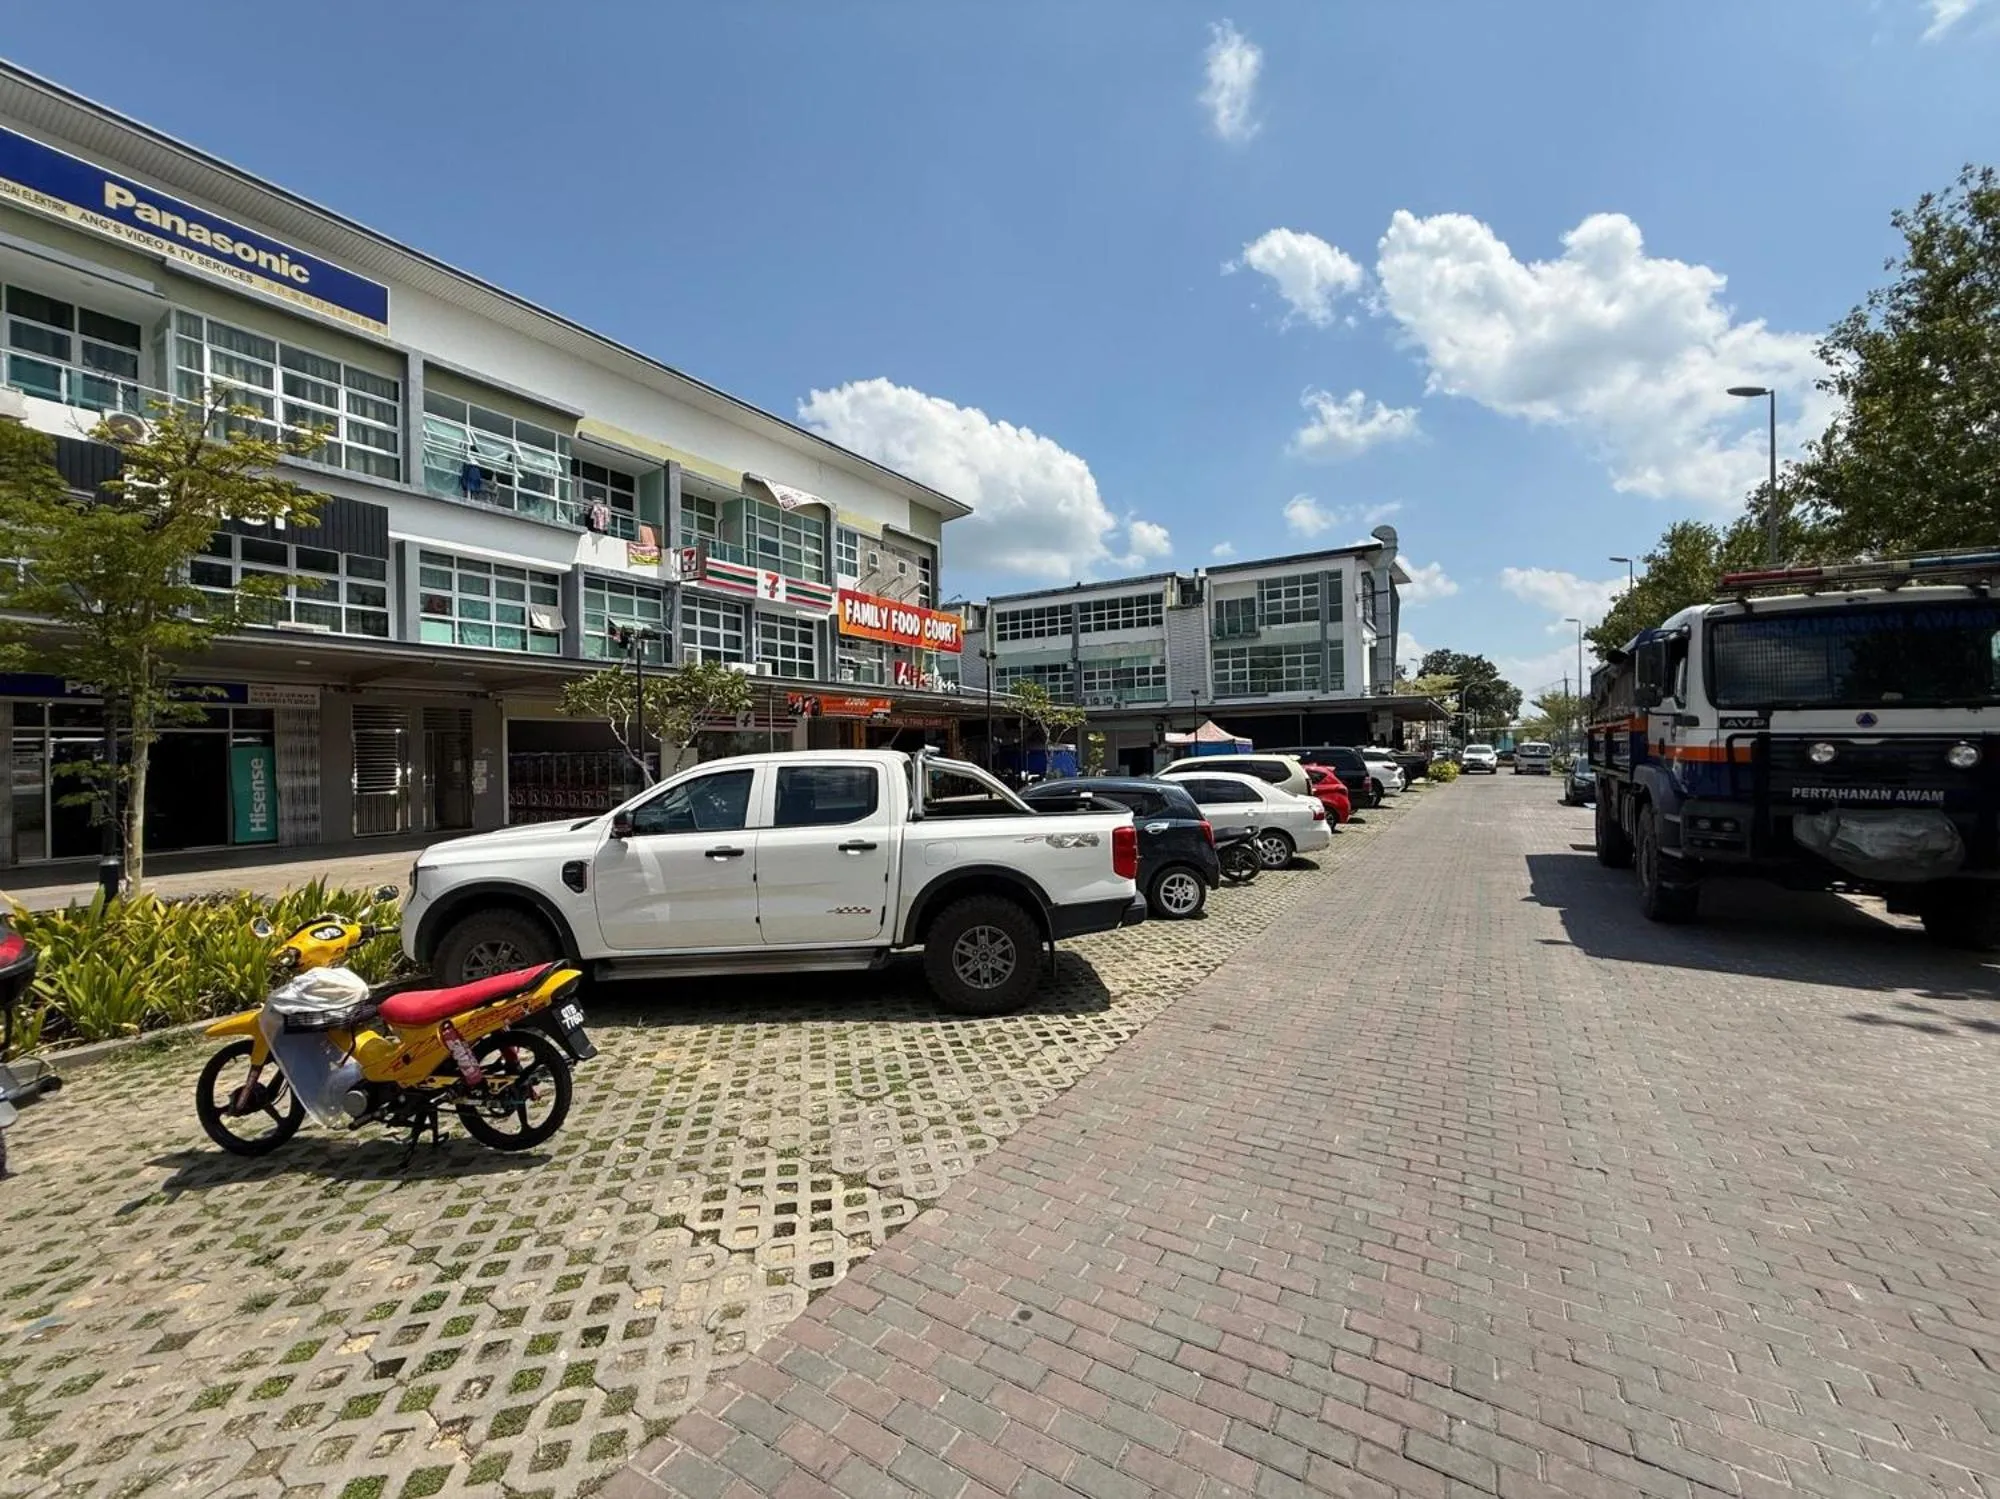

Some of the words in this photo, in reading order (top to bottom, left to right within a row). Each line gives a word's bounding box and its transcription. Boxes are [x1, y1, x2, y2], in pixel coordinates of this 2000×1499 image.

[22, 190, 68, 214] ELEKTRIK
[79, 212, 122, 234] ANG'S
[125, 228, 164, 249] VIDEO
[167, 244, 177, 255] &
[179, 249, 195, 261] TV
[198, 255, 254, 284] SERVICES
[104, 181, 310, 284] Panasonic
[764, 572, 780, 599] 7
[844, 599, 889, 630] FAMILY
[891, 609, 921, 637] FOOD
[924, 617, 958, 643] COURT
[248, 758, 268, 832] Hisense
[1791, 786, 1892, 801] PERTAHANAN
[1895, 789, 1945, 802] AWAM
